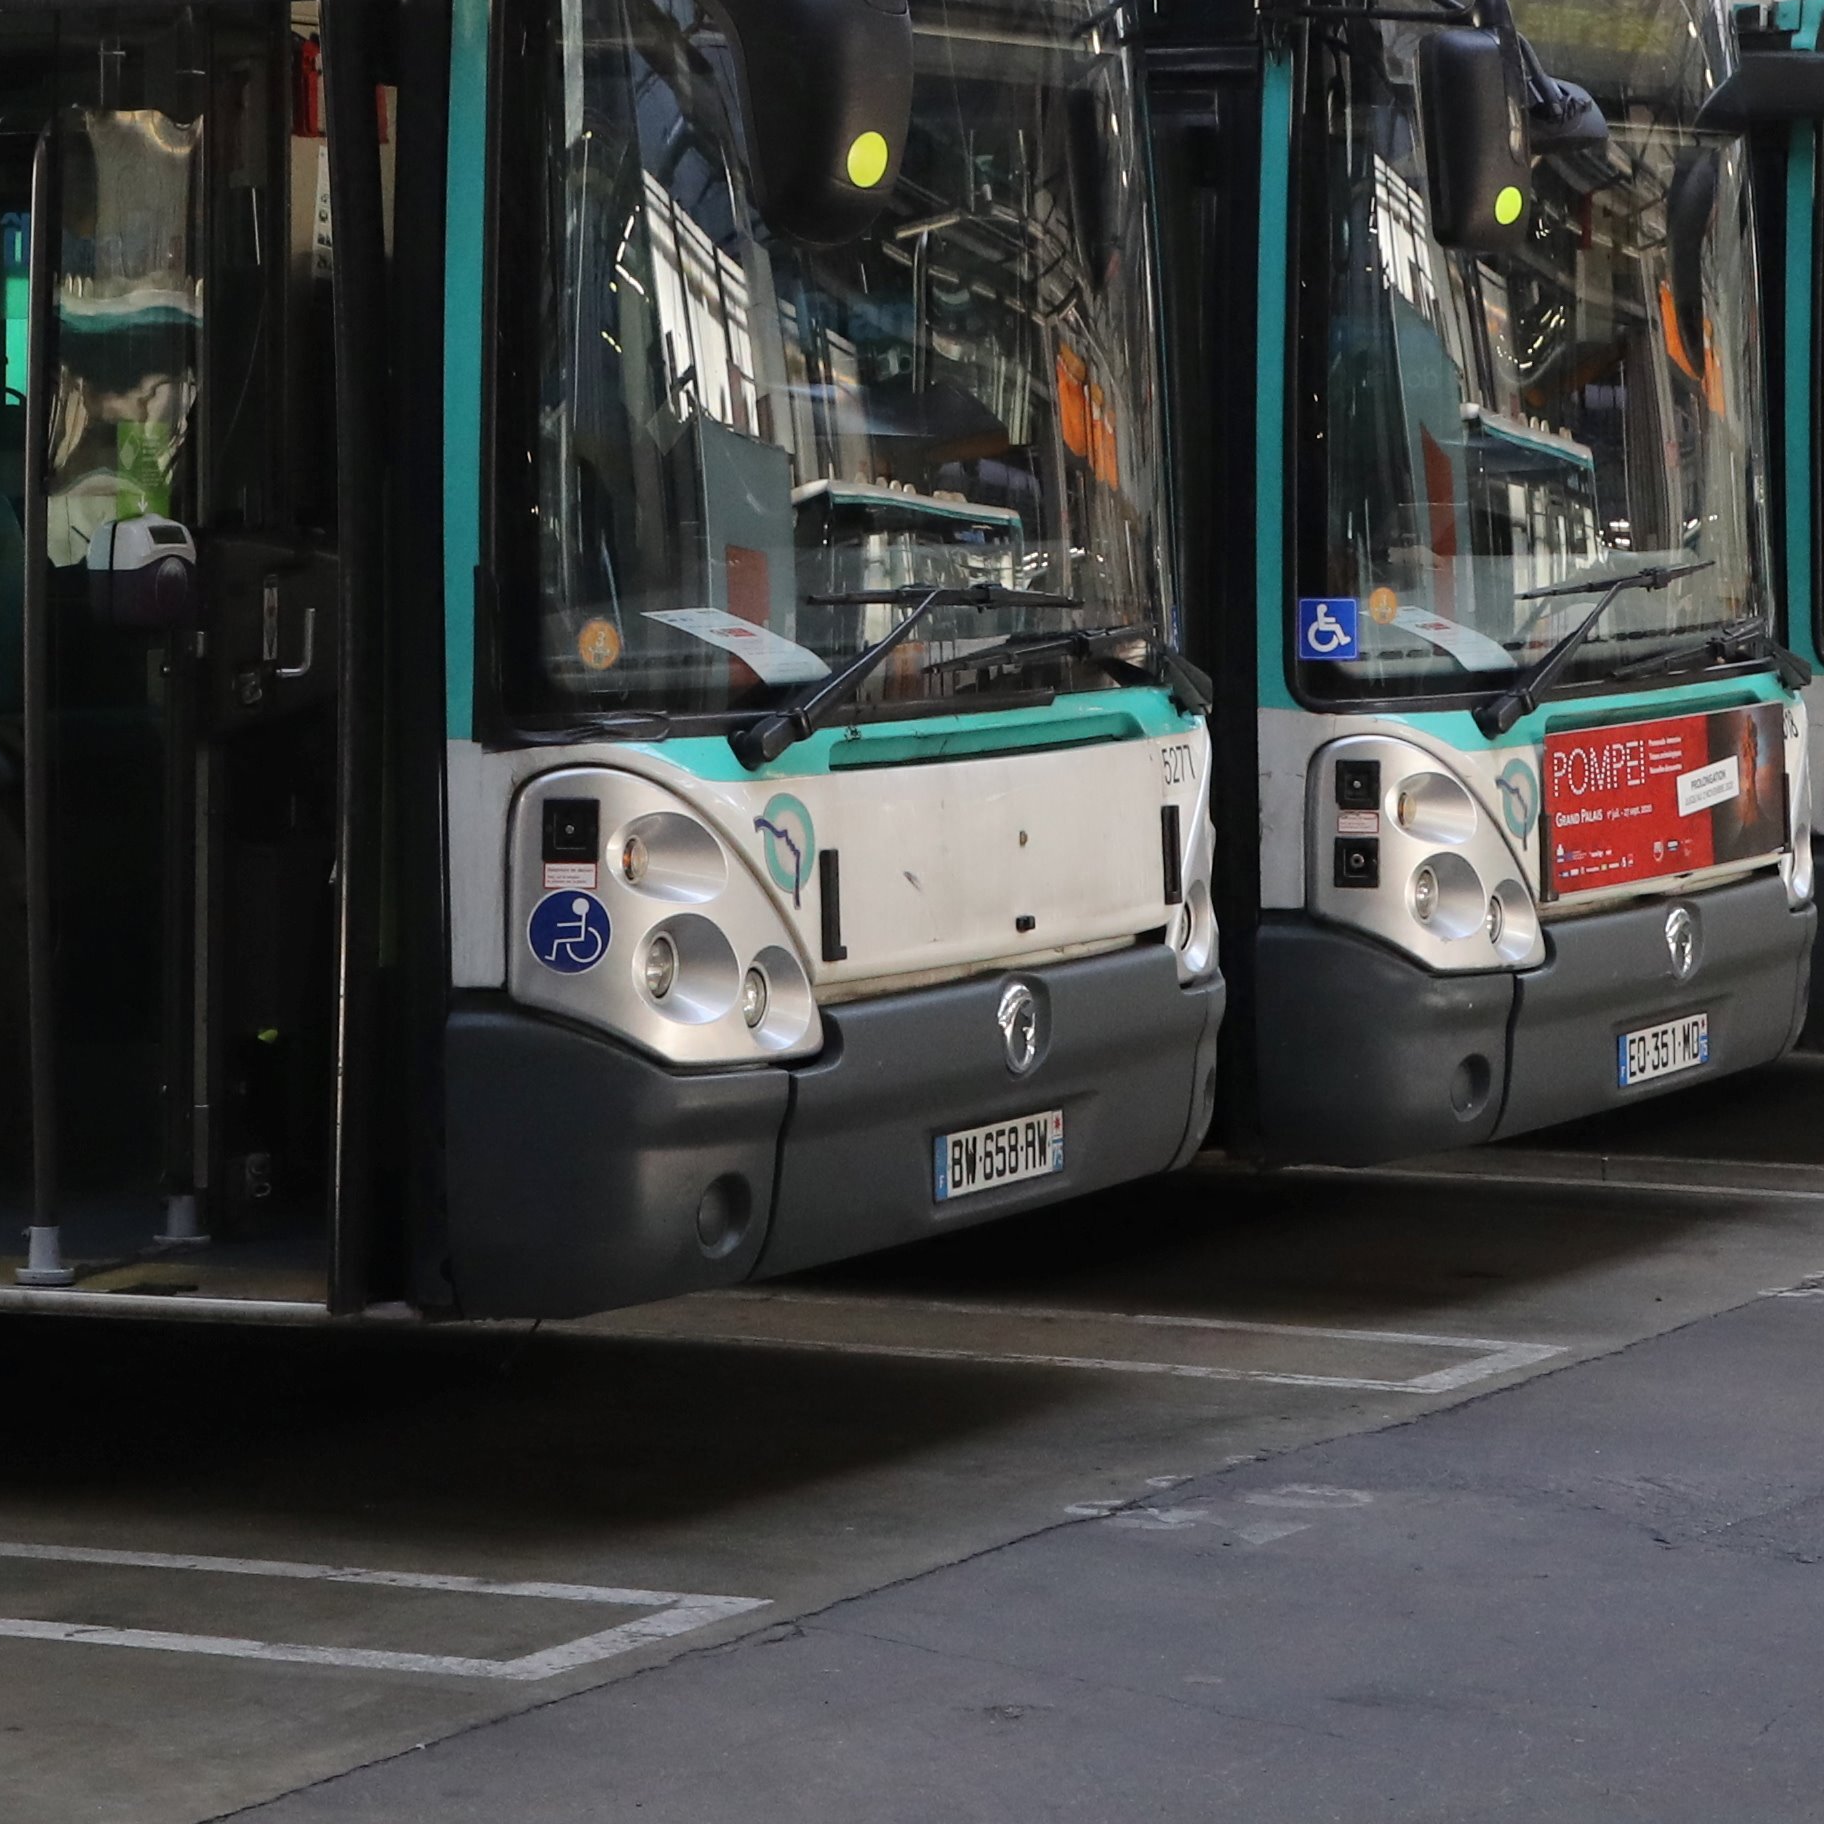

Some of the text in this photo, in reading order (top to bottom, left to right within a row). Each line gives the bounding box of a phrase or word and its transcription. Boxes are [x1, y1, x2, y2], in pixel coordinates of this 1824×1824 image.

[1161, 744, 1195, 785] 5277
[1552, 739, 1646, 798] POMPEI
[1555, 811, 1580, 827] GRAND
[1581, 808, 1603, 823] PALAIS
[951, 1119, 1048, 1189] BW-658-RW
